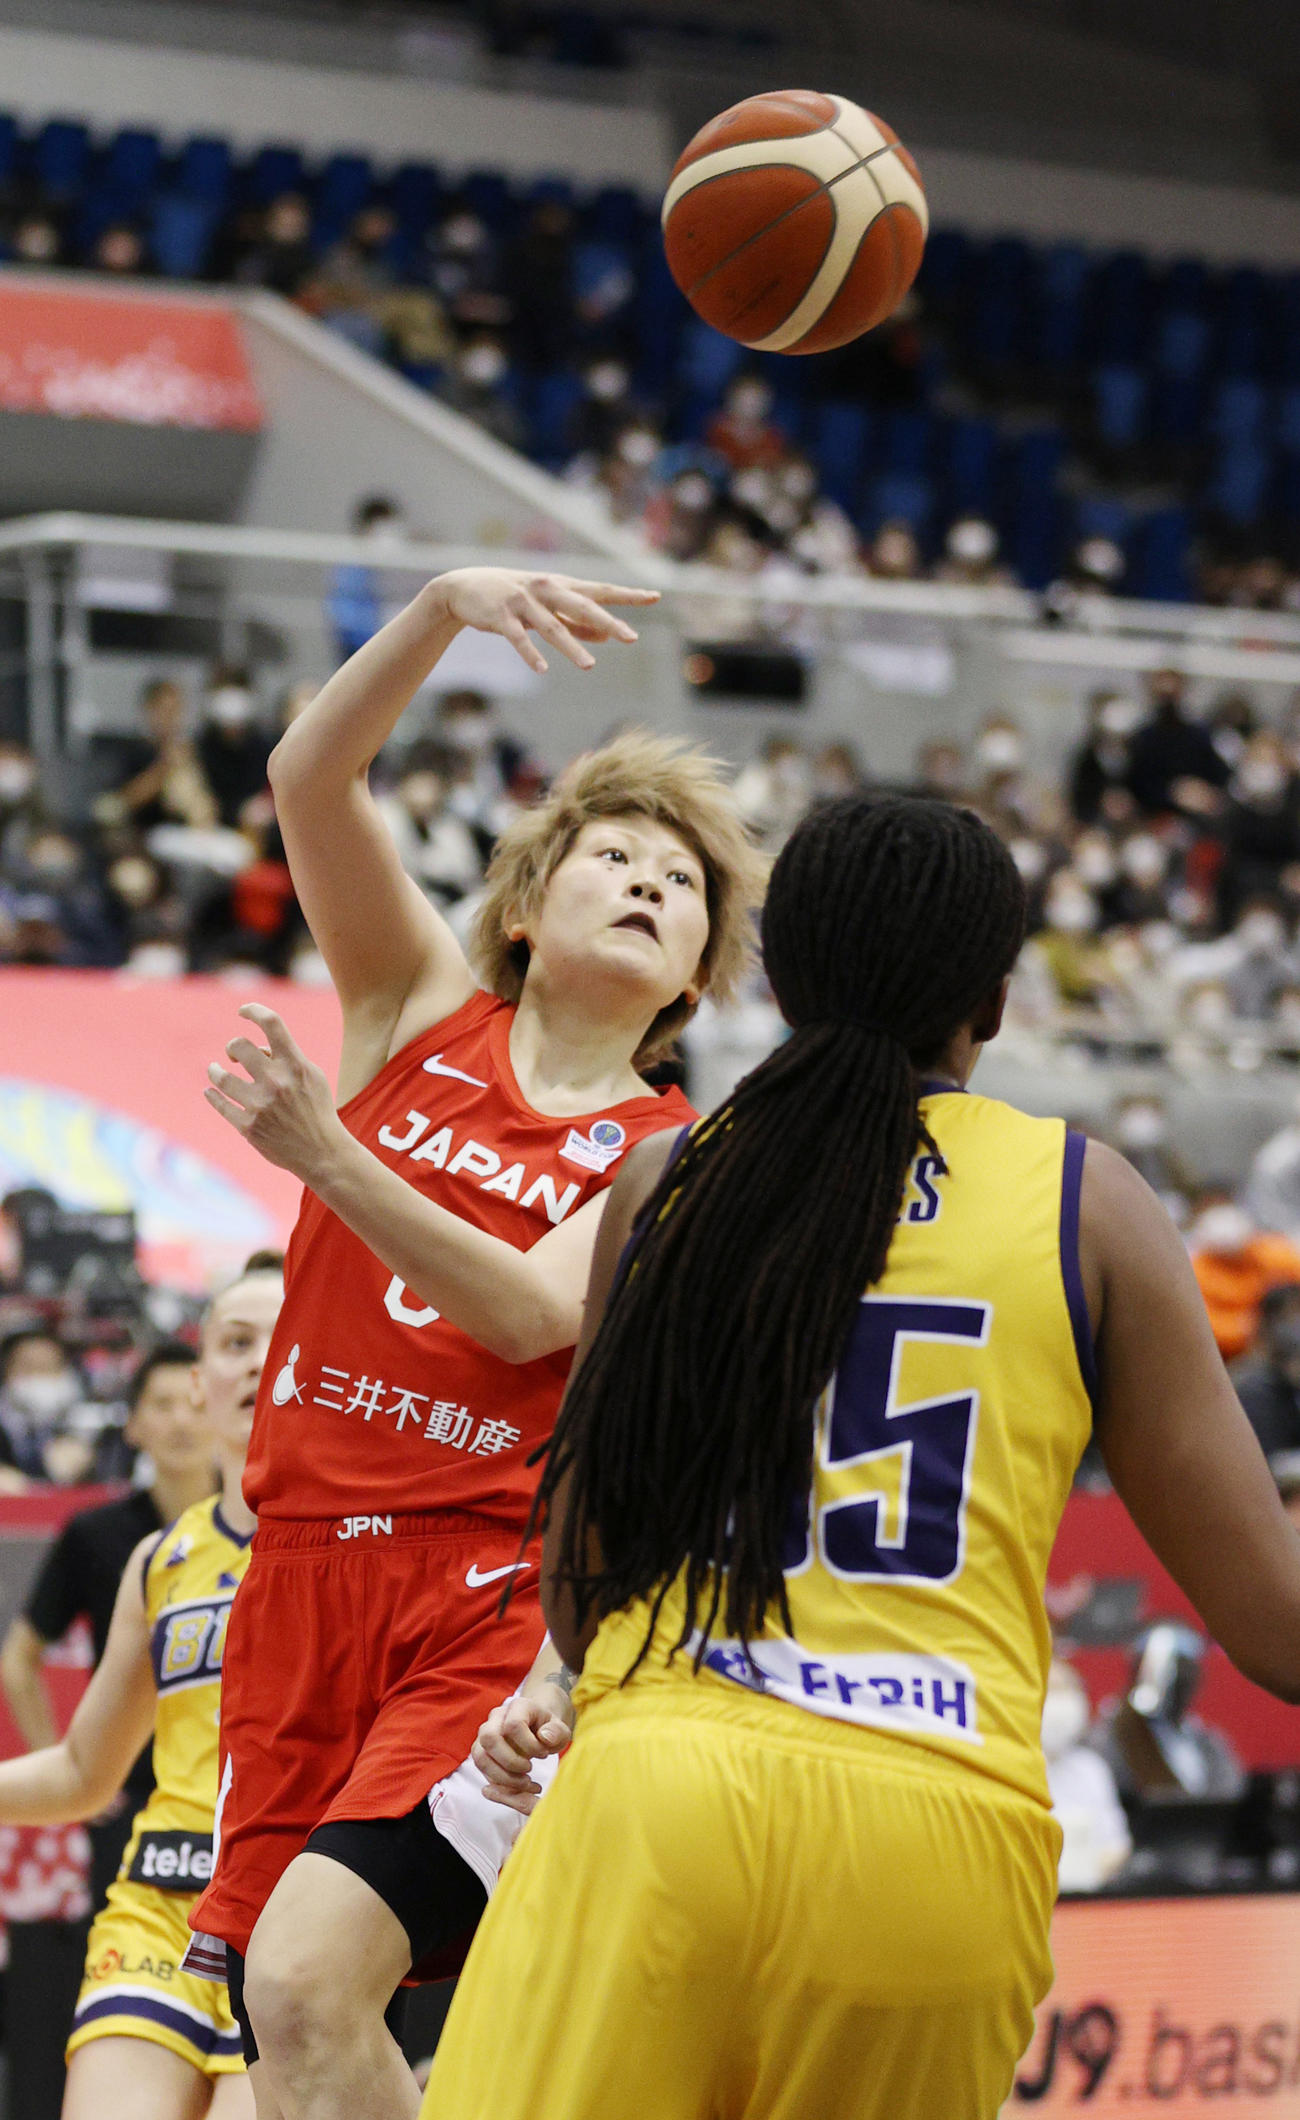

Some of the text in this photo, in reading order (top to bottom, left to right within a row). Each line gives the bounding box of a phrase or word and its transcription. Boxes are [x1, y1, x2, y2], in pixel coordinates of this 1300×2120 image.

[378, 1109, 581, 1225] JAPAN
[313, 1366, 521, 1456] 三井不動産
[336, 1514, 393, 1540] JPN
